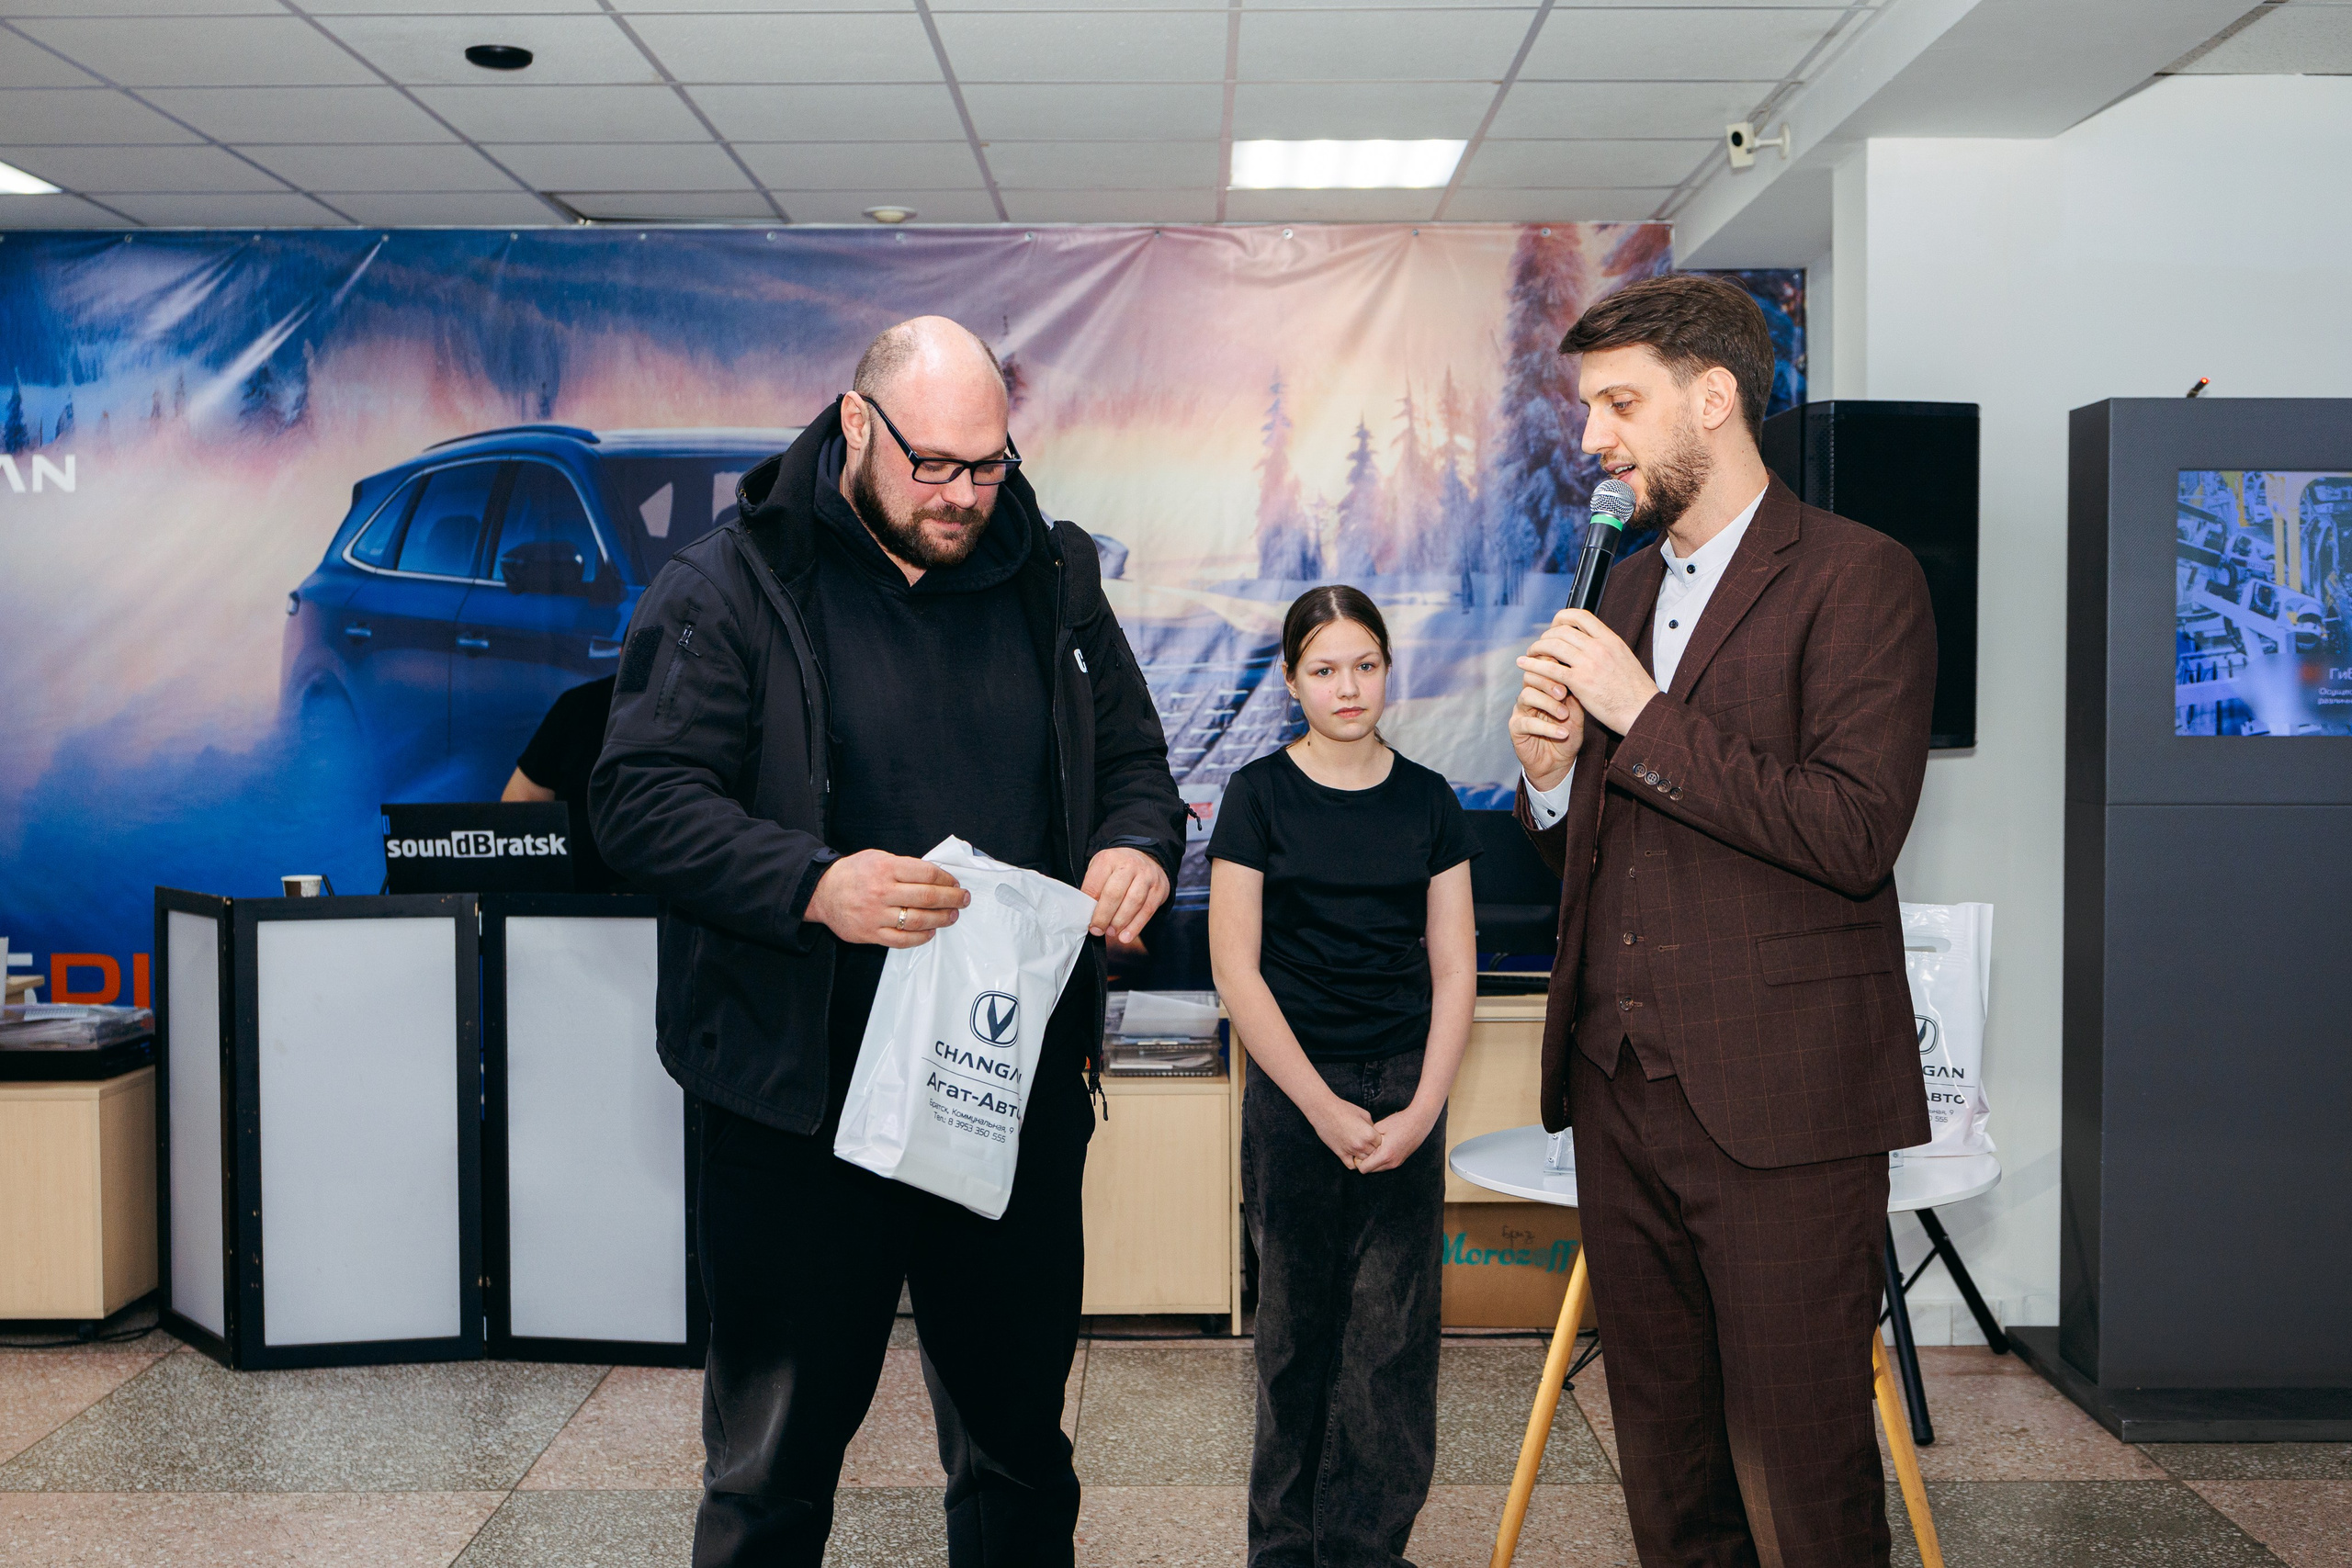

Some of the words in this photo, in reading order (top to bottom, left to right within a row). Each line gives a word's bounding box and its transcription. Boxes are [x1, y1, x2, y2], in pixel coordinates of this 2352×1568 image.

[387, 830, 568, 858] soundBratsk
[947, 1117, 954, 1126] 8
[955, 1120, 974, 1133] 3953
[974, 1126, 990, 1138] 350
[991, 1132, 1007, 1144] 555
